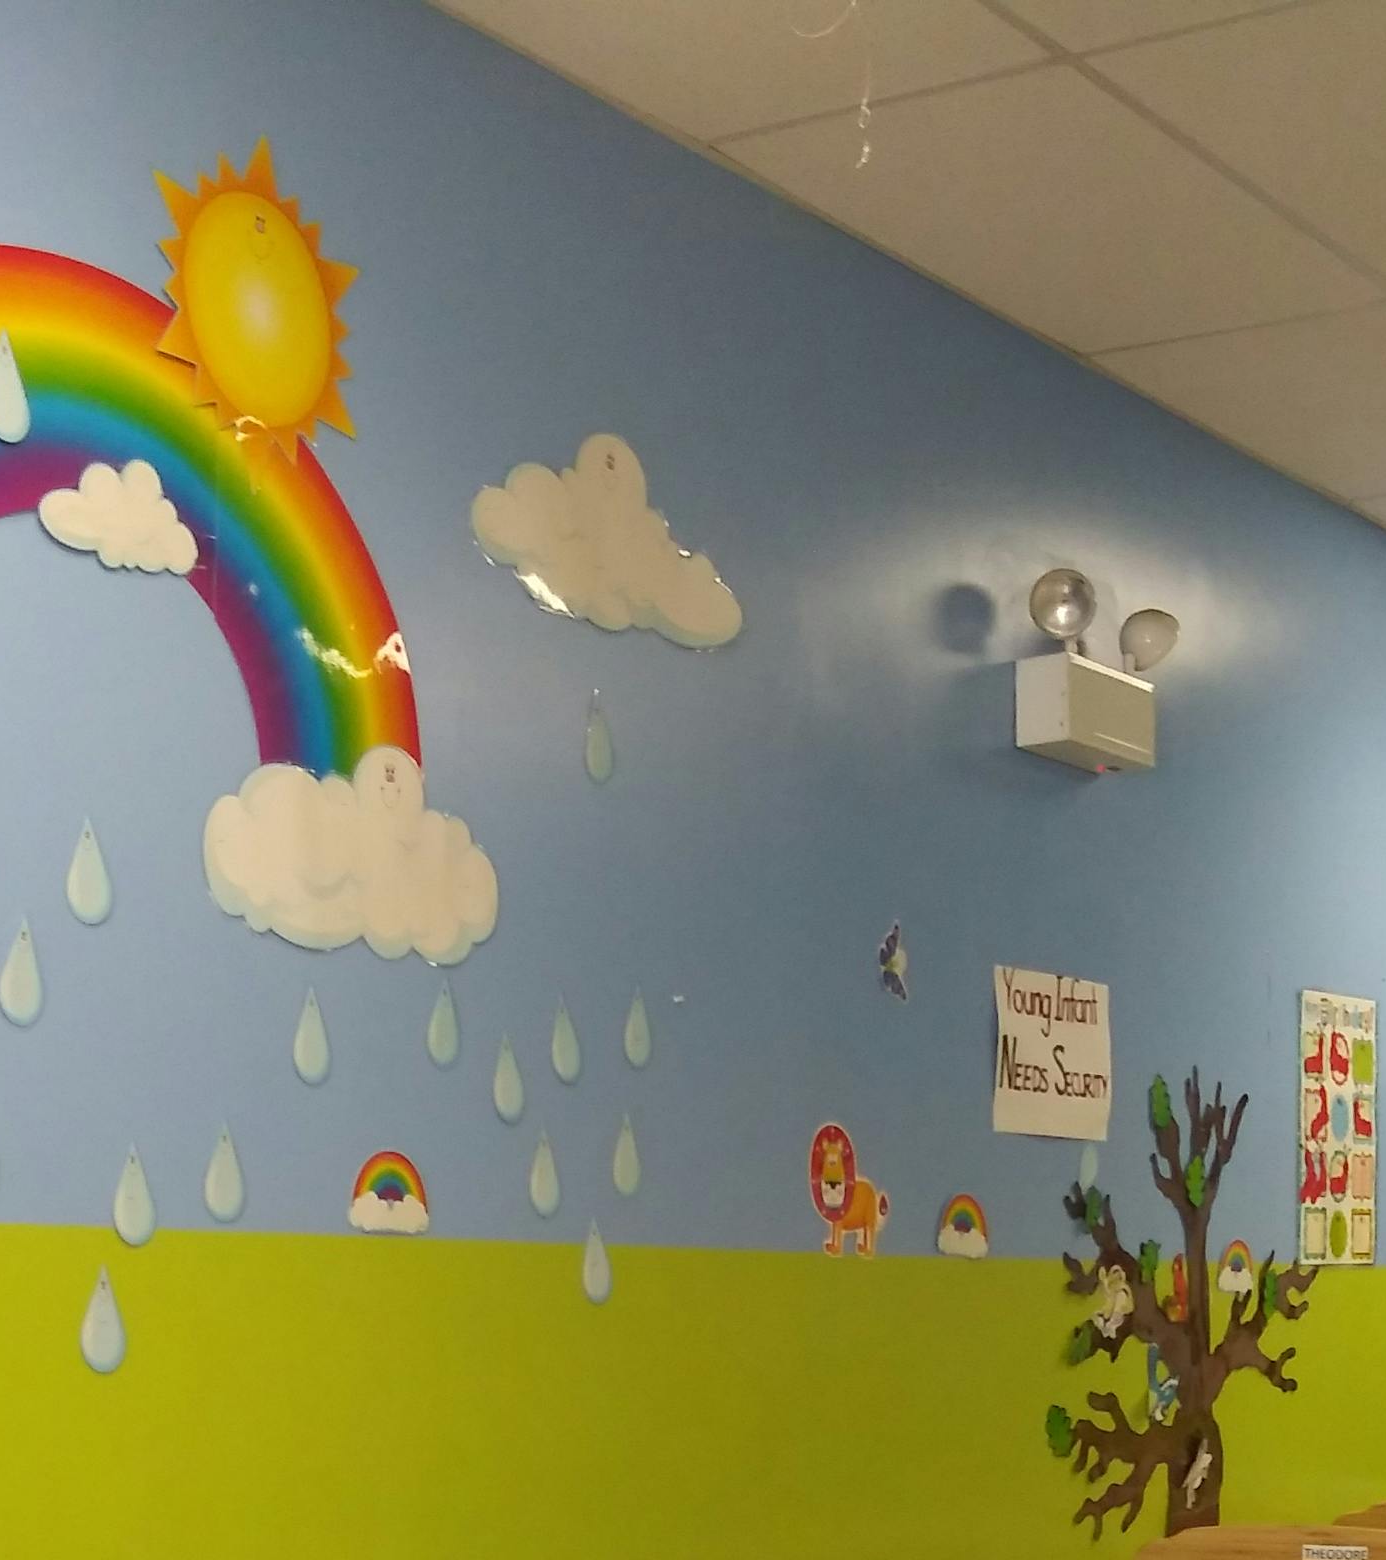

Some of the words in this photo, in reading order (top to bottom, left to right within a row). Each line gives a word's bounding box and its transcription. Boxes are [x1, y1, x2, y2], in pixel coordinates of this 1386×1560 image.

[1002, 967, 1052, 1038] Young
[1054, 975, 1098, 1025] Infant
[1305, 1548, 1367, 1560] THEODORE
